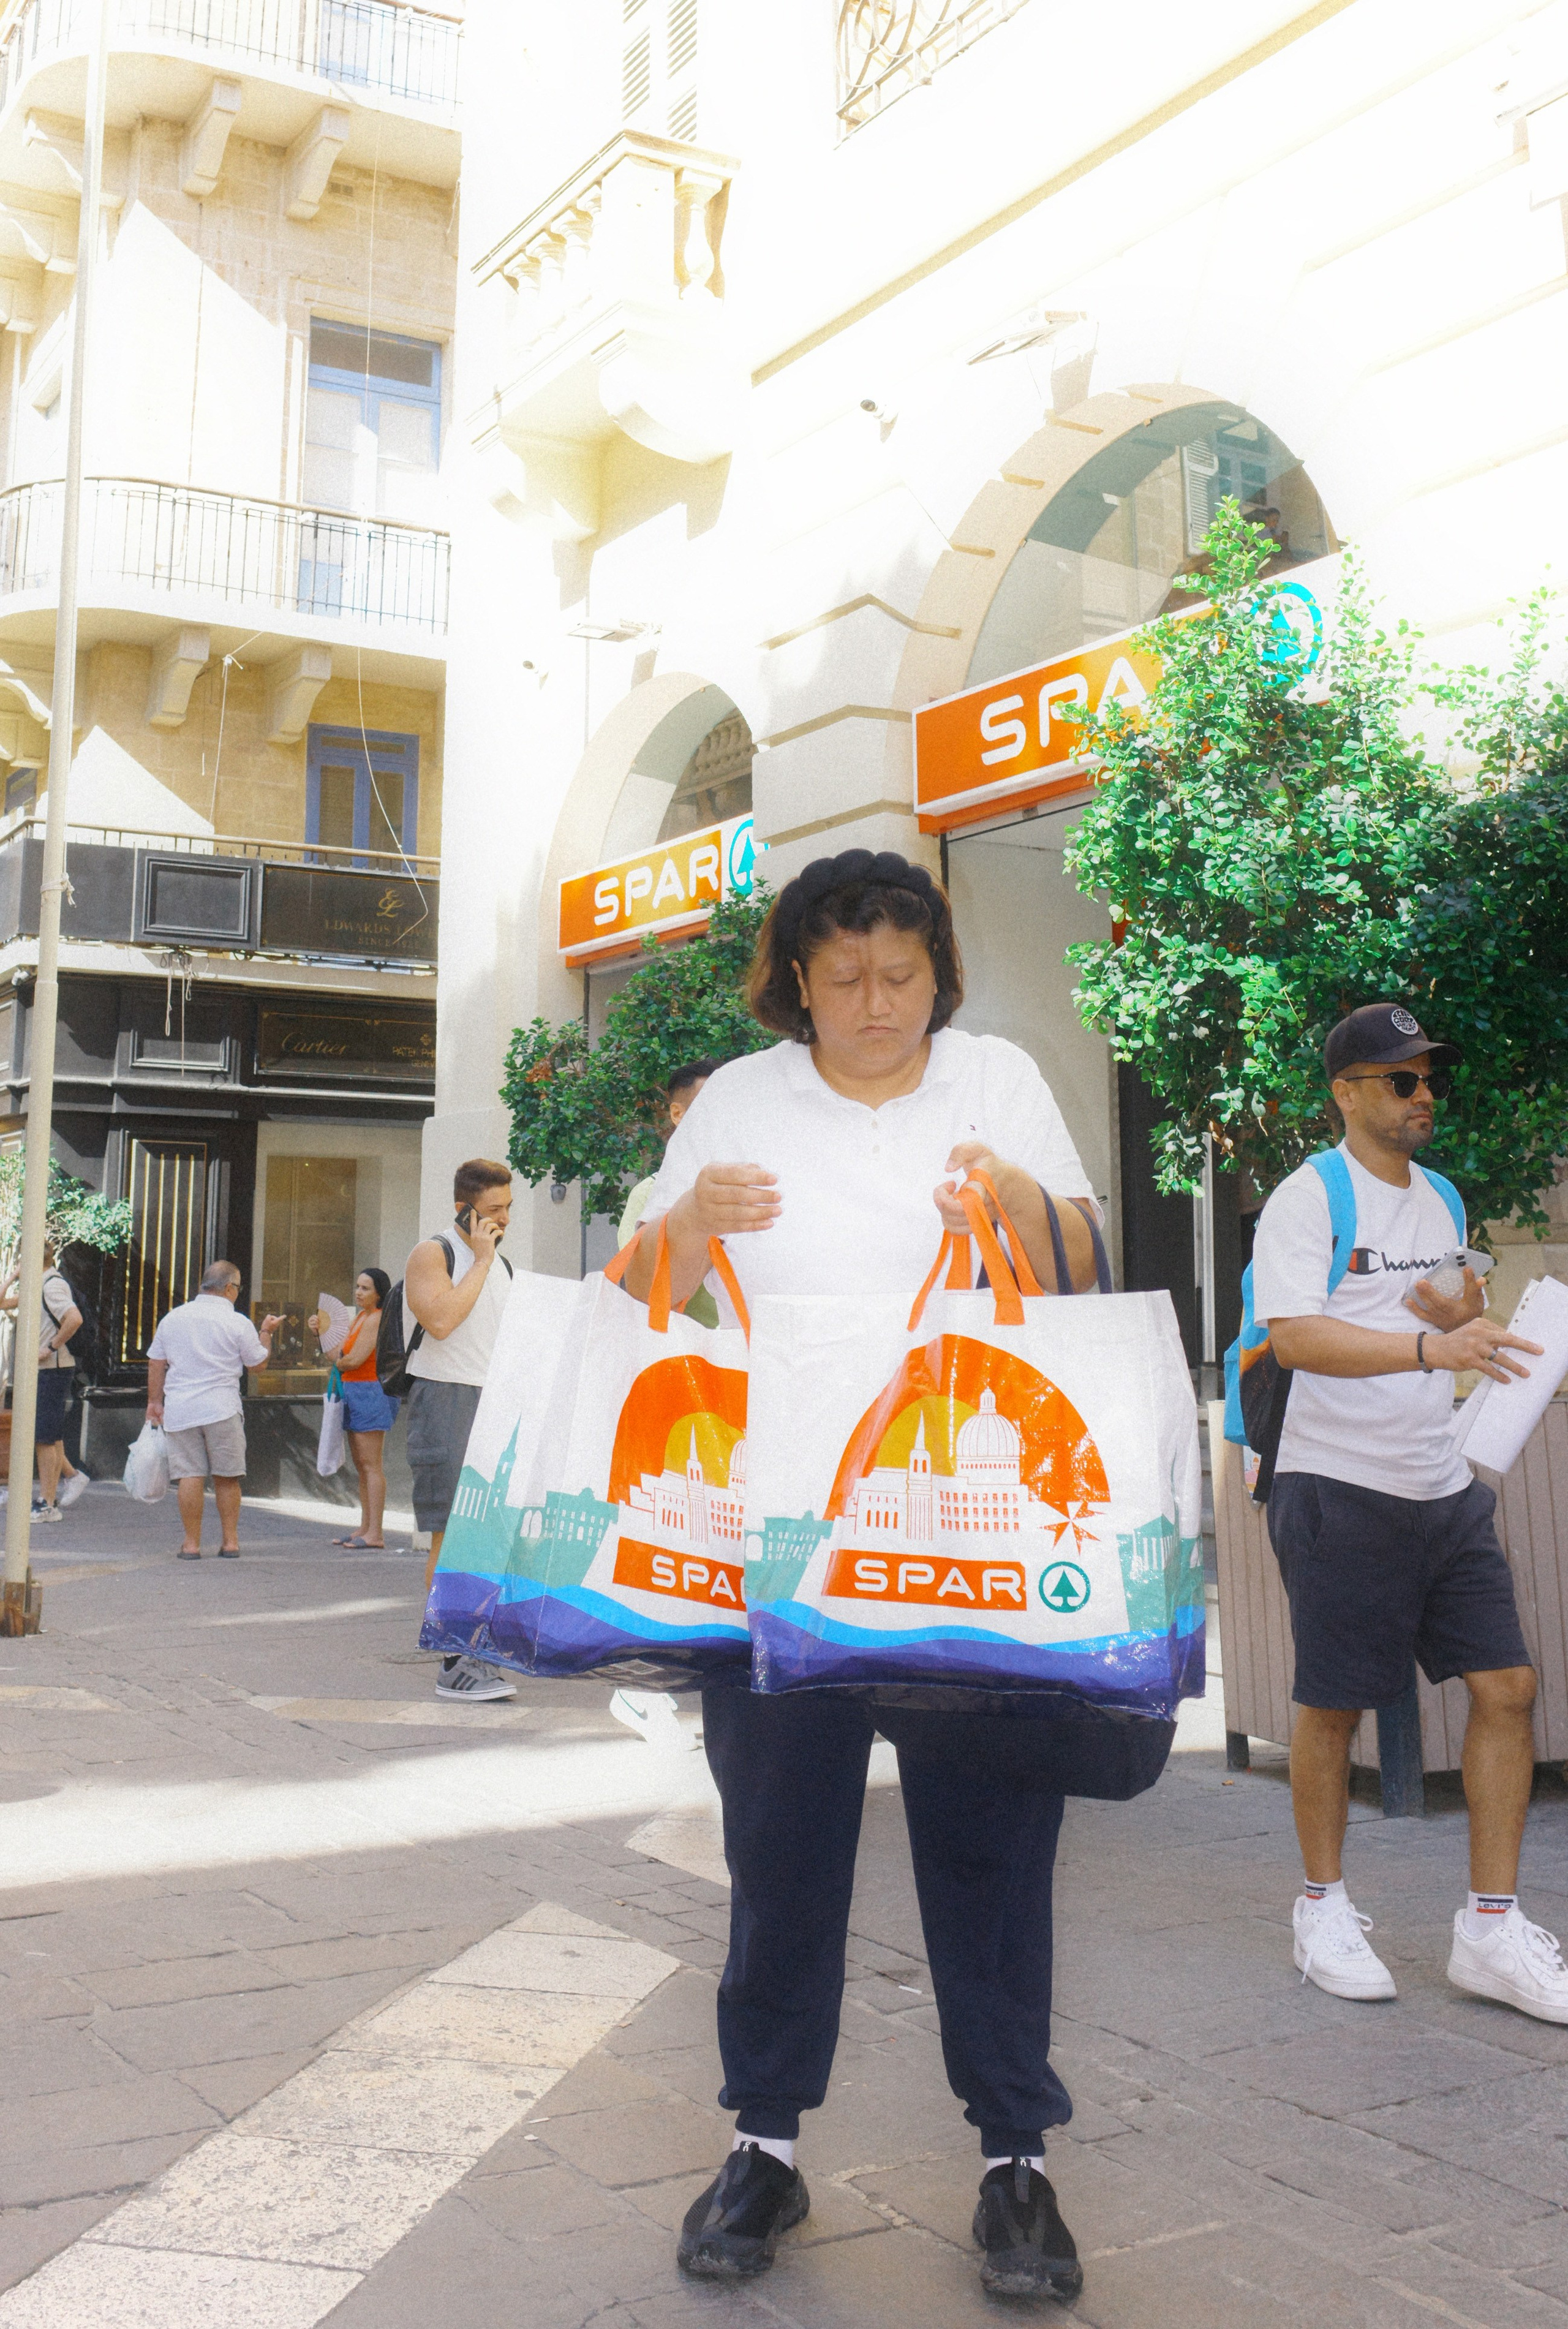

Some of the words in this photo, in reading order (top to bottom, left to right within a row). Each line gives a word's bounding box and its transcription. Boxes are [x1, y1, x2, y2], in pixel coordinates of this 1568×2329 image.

[980, 655, 1164, 766] SPA
[594, 844, 719, 926] SPAR
[281, 1032, 347, 1055] Cartier
[1348, 1248, 1447, 1275] Cham
[651, 1554, 746, 1604] SPA
[854, 1558, 1022, 1602] SPAR
